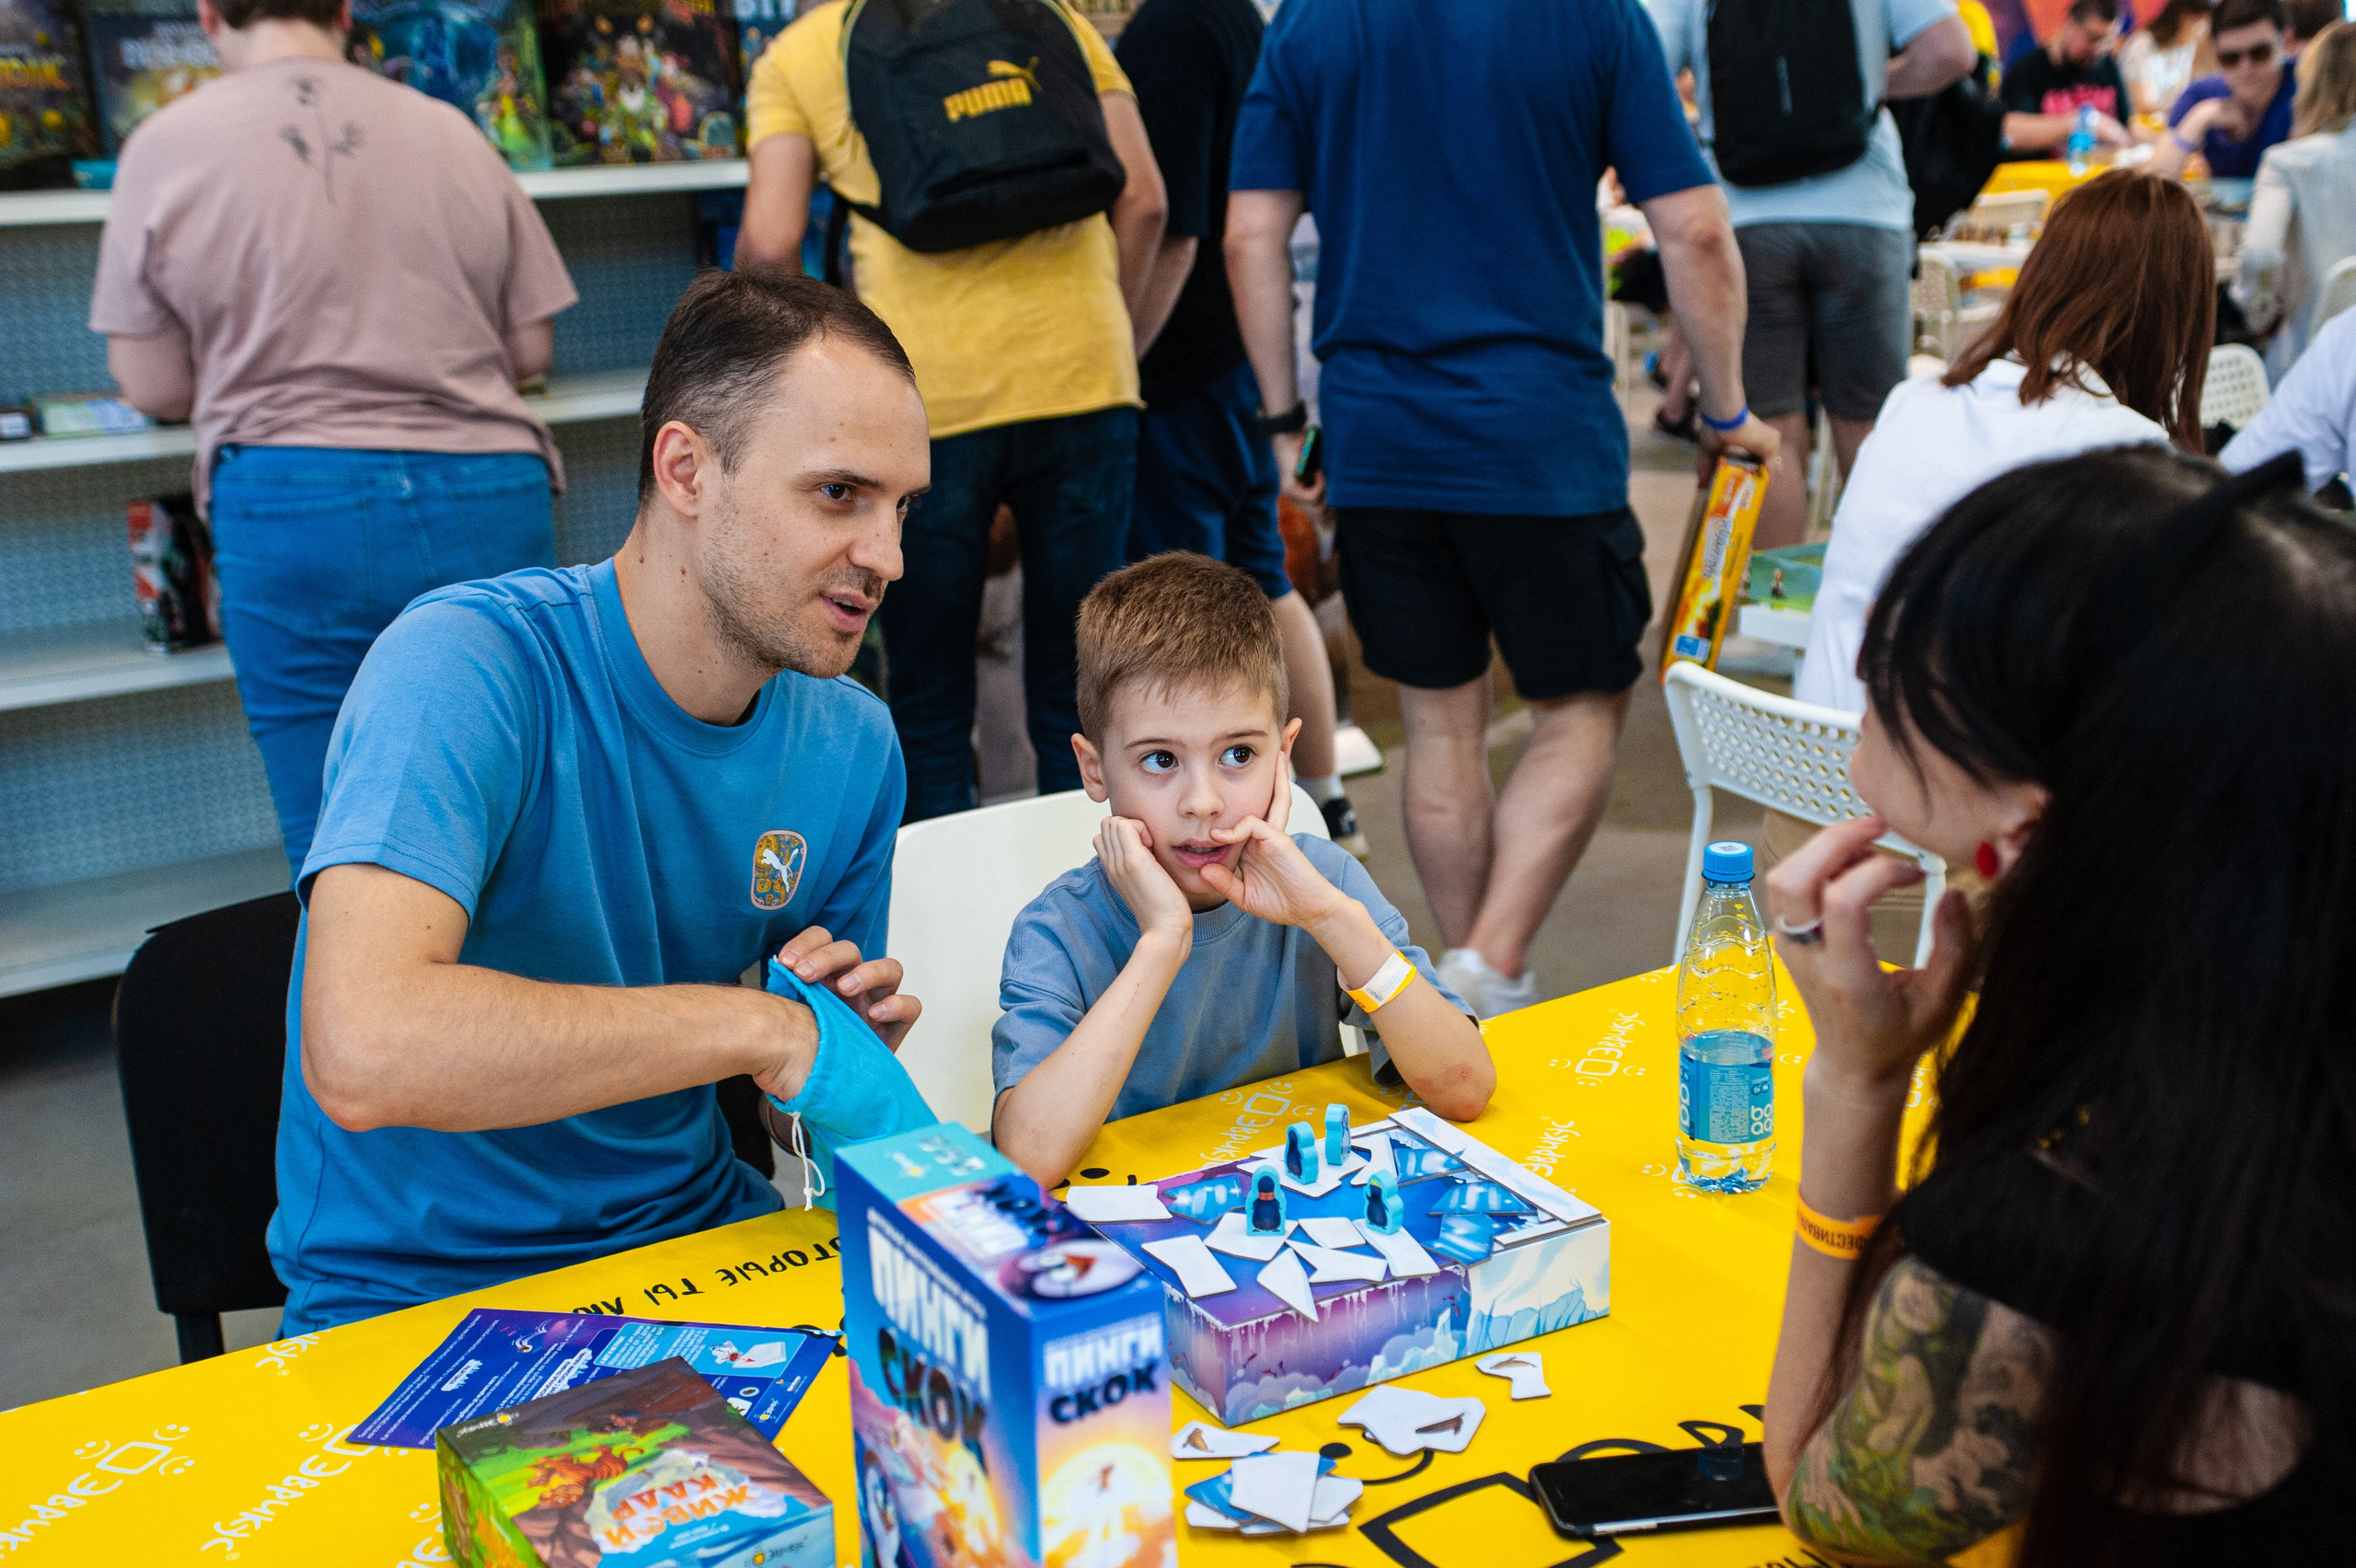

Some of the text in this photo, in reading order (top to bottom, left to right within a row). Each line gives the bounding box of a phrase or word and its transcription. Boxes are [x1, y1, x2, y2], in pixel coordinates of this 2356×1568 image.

[944, 79, 1034, 122] PUMA
[1588, 1012, 1646, 1059] Эврикус
[643, 1277, 705, 1307] ТЫ
[714, 1237, 841, 1287] ОТОРЫЕ
[868, 1224, 990, 1401] ПИНГИ
[1044, 1322, 1164, 1390] ПИНГИ
[877, 1327, 990, 1458] СКОК
[1050, 1361, 1161, 1426] СКОК
[0, 1472, 124, 1560] Эврик
[201, 1453, 352, 1552] Эврикус
[611, 1473, 719, 1523] КАДР
